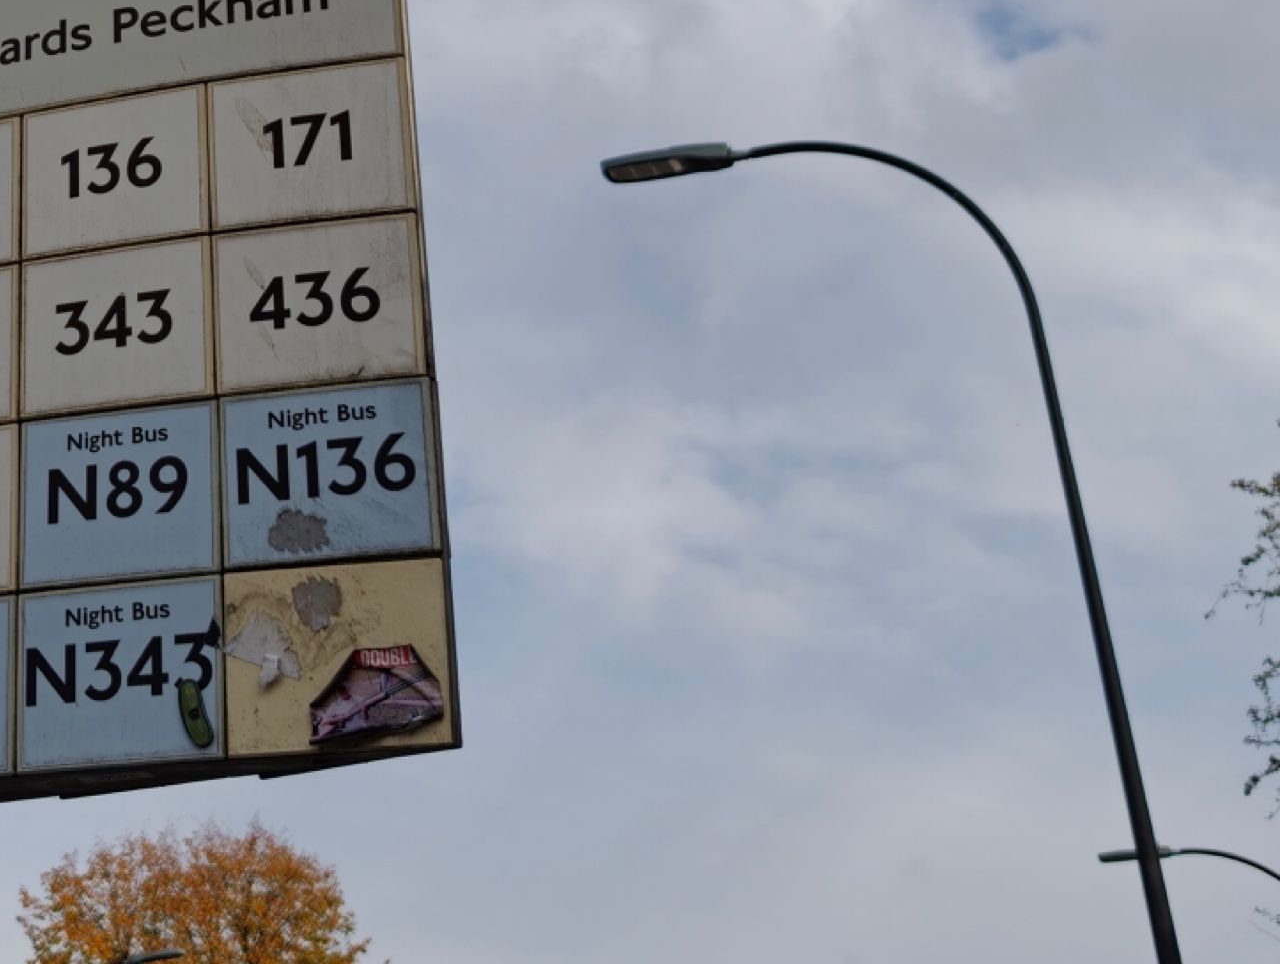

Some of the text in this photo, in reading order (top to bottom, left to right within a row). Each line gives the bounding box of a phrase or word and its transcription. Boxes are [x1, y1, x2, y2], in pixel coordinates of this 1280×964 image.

[60, 137, 162, 198] 136
[262, 110, 353, 169] 171
[55, 289, 173, 356] 343
[250, 268, 380, 330] 436
[67, 426, 168, 453] Night Bus
[268, 403, 377, 431] Night Bus
[48, 456, 188, 524] N89
[236, 432, 416, 505] N136
[65, 602, 170, 628] Night Bus
[25, 633, 213, 706] N343
